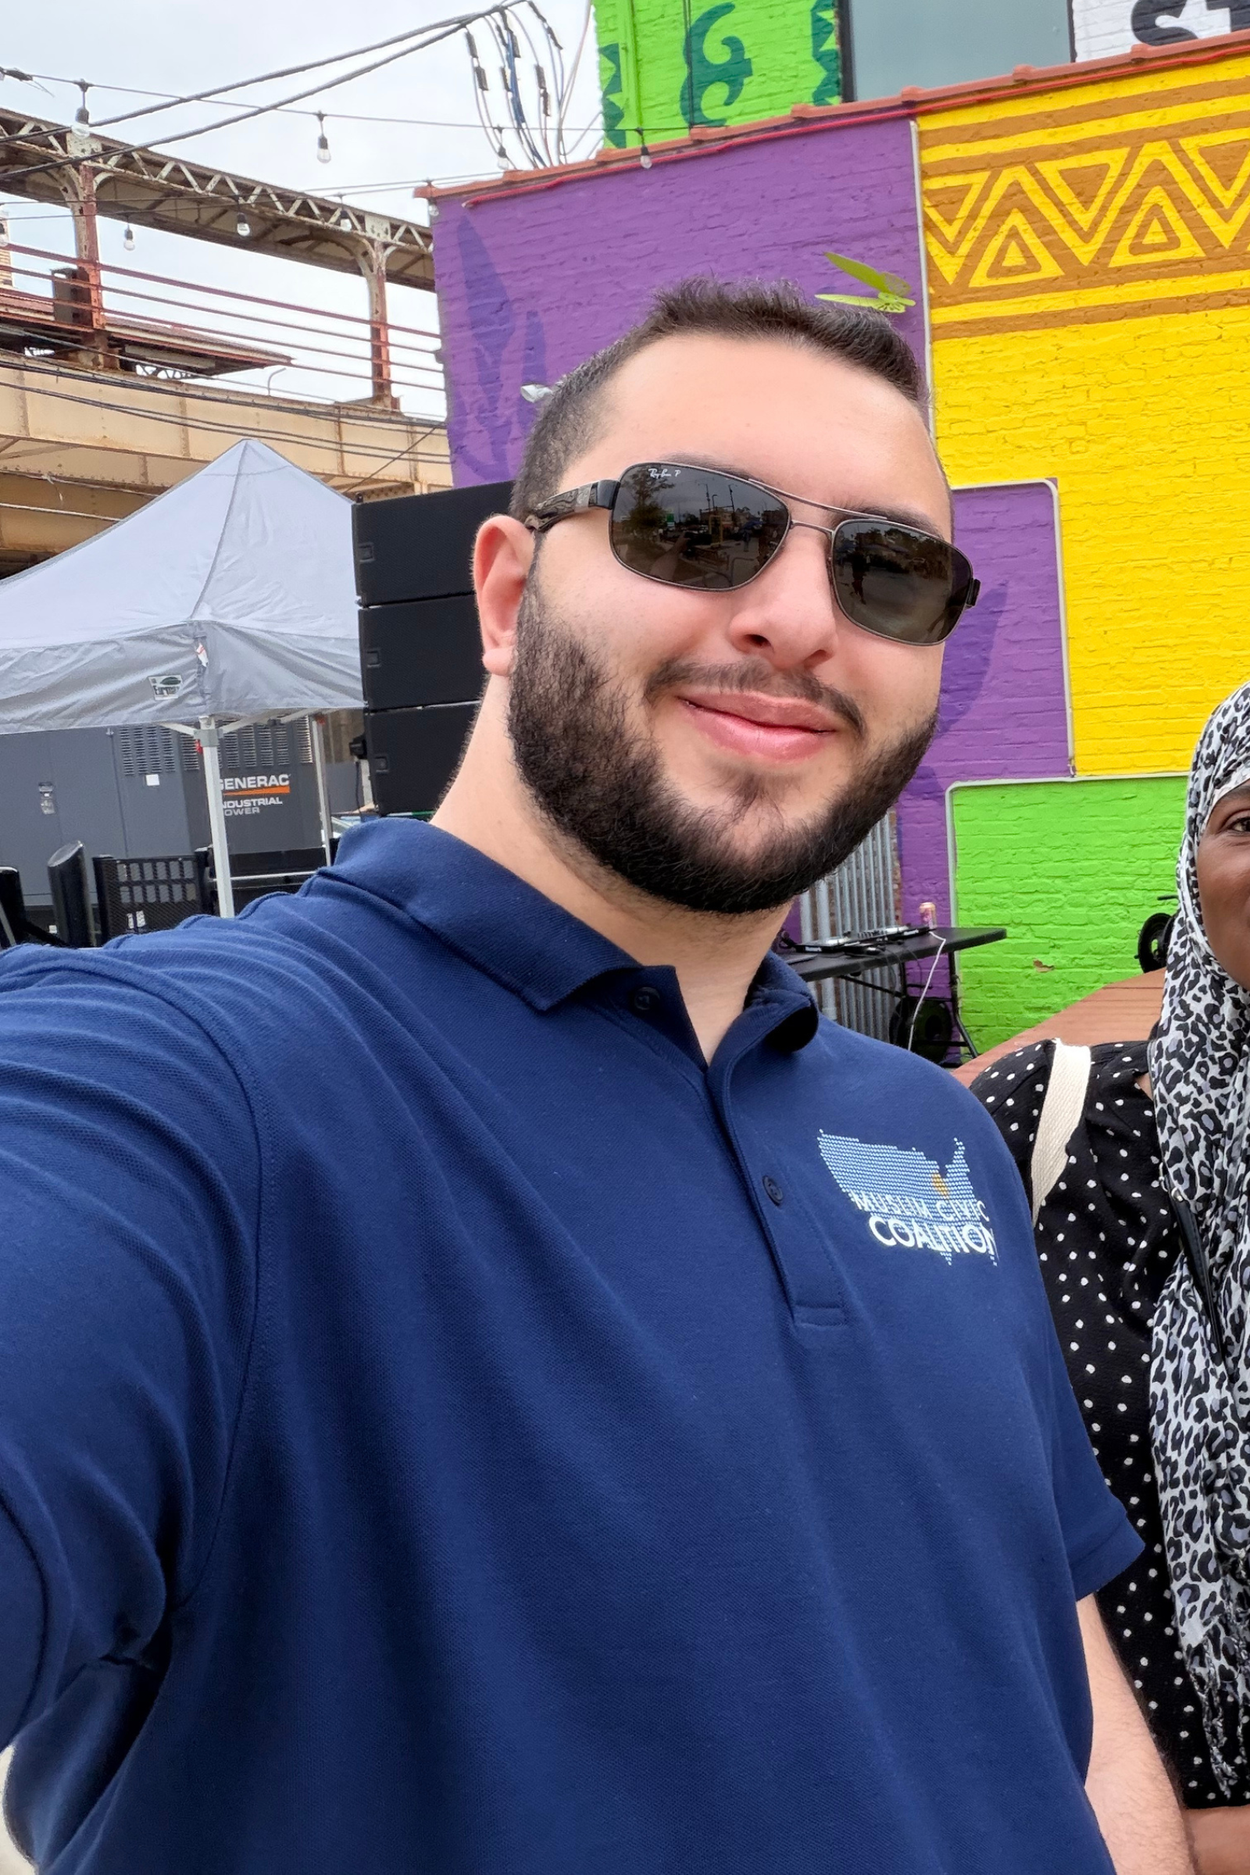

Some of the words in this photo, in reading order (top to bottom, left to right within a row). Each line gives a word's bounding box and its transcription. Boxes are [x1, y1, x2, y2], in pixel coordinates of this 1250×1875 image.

[224, 806, 260, 817] OWER
[848, 1190, 933, 1219] MUSLIM
[936, 1200, 990, 1222] CIVIC
[868, 1215, 998, 1259] COALITION
